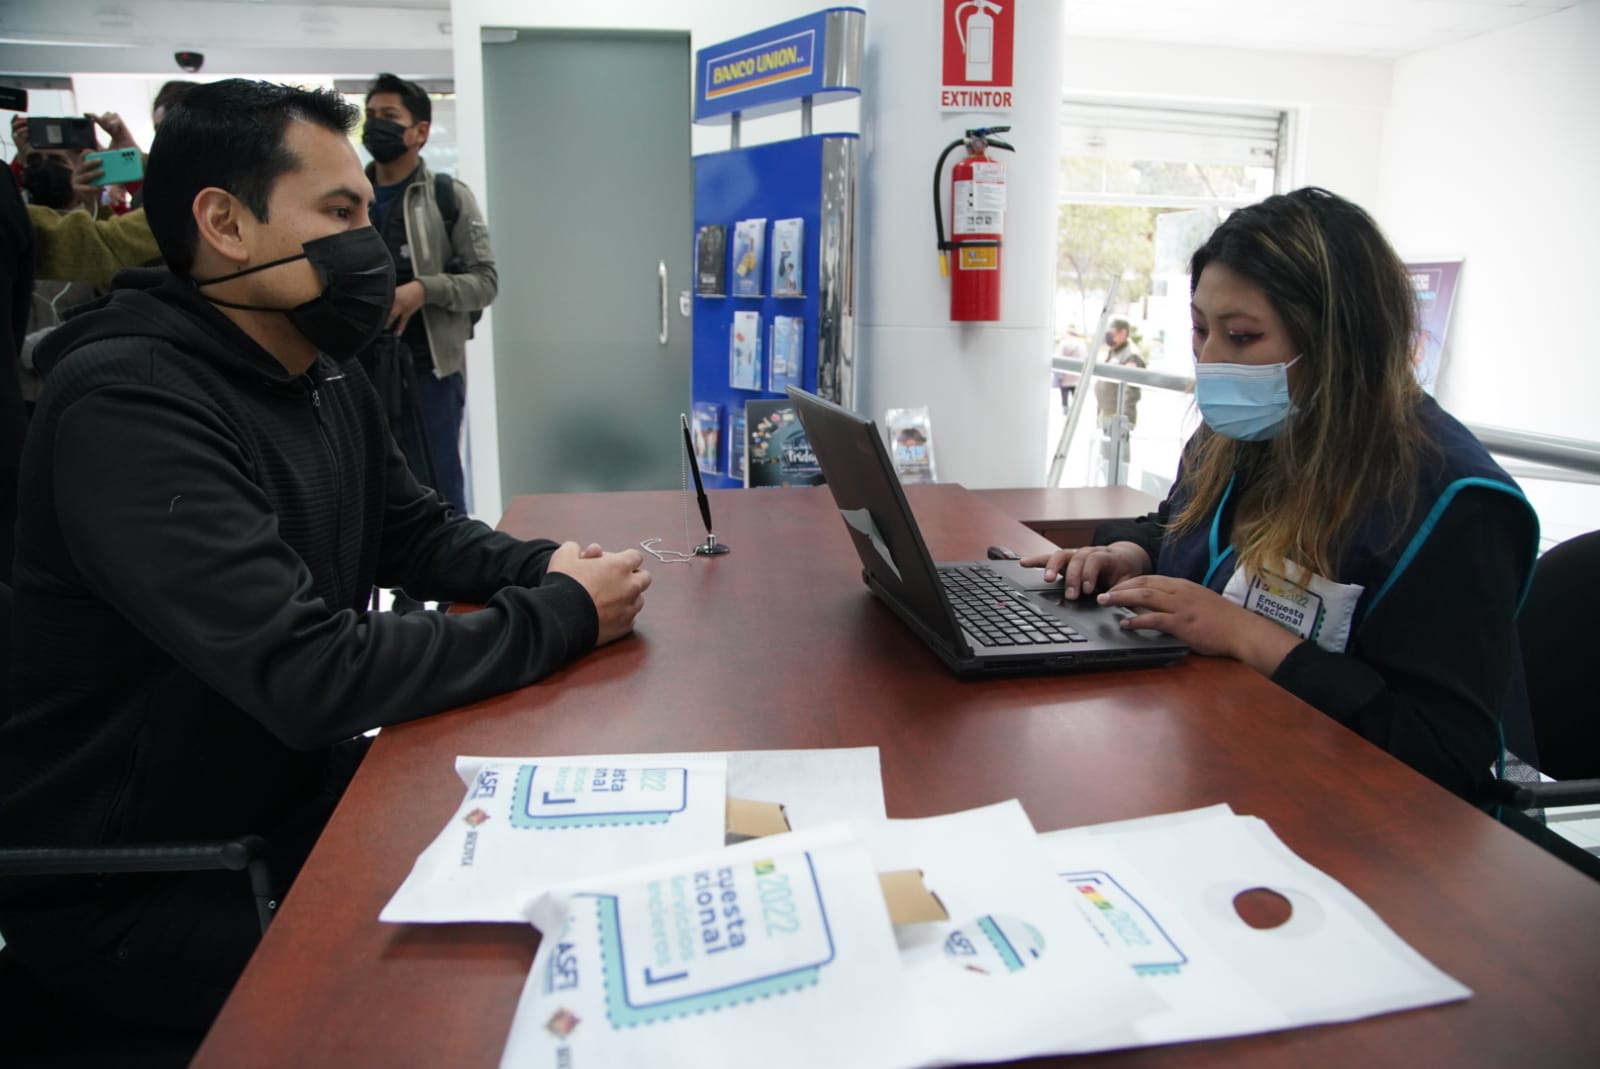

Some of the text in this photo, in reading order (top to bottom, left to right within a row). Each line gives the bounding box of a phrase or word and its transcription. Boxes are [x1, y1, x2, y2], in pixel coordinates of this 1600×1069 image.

[713, 44, 797, 85] BANCO UNION
[941, 90, 1012, 107] EXTINTOR
[1255, 602, 1304, 627] Nacional
[1257, 594, 1305, 619] Encuesta
[756, 873, 800, 939] 2022
[556, 943, 578, 989] ASFI
